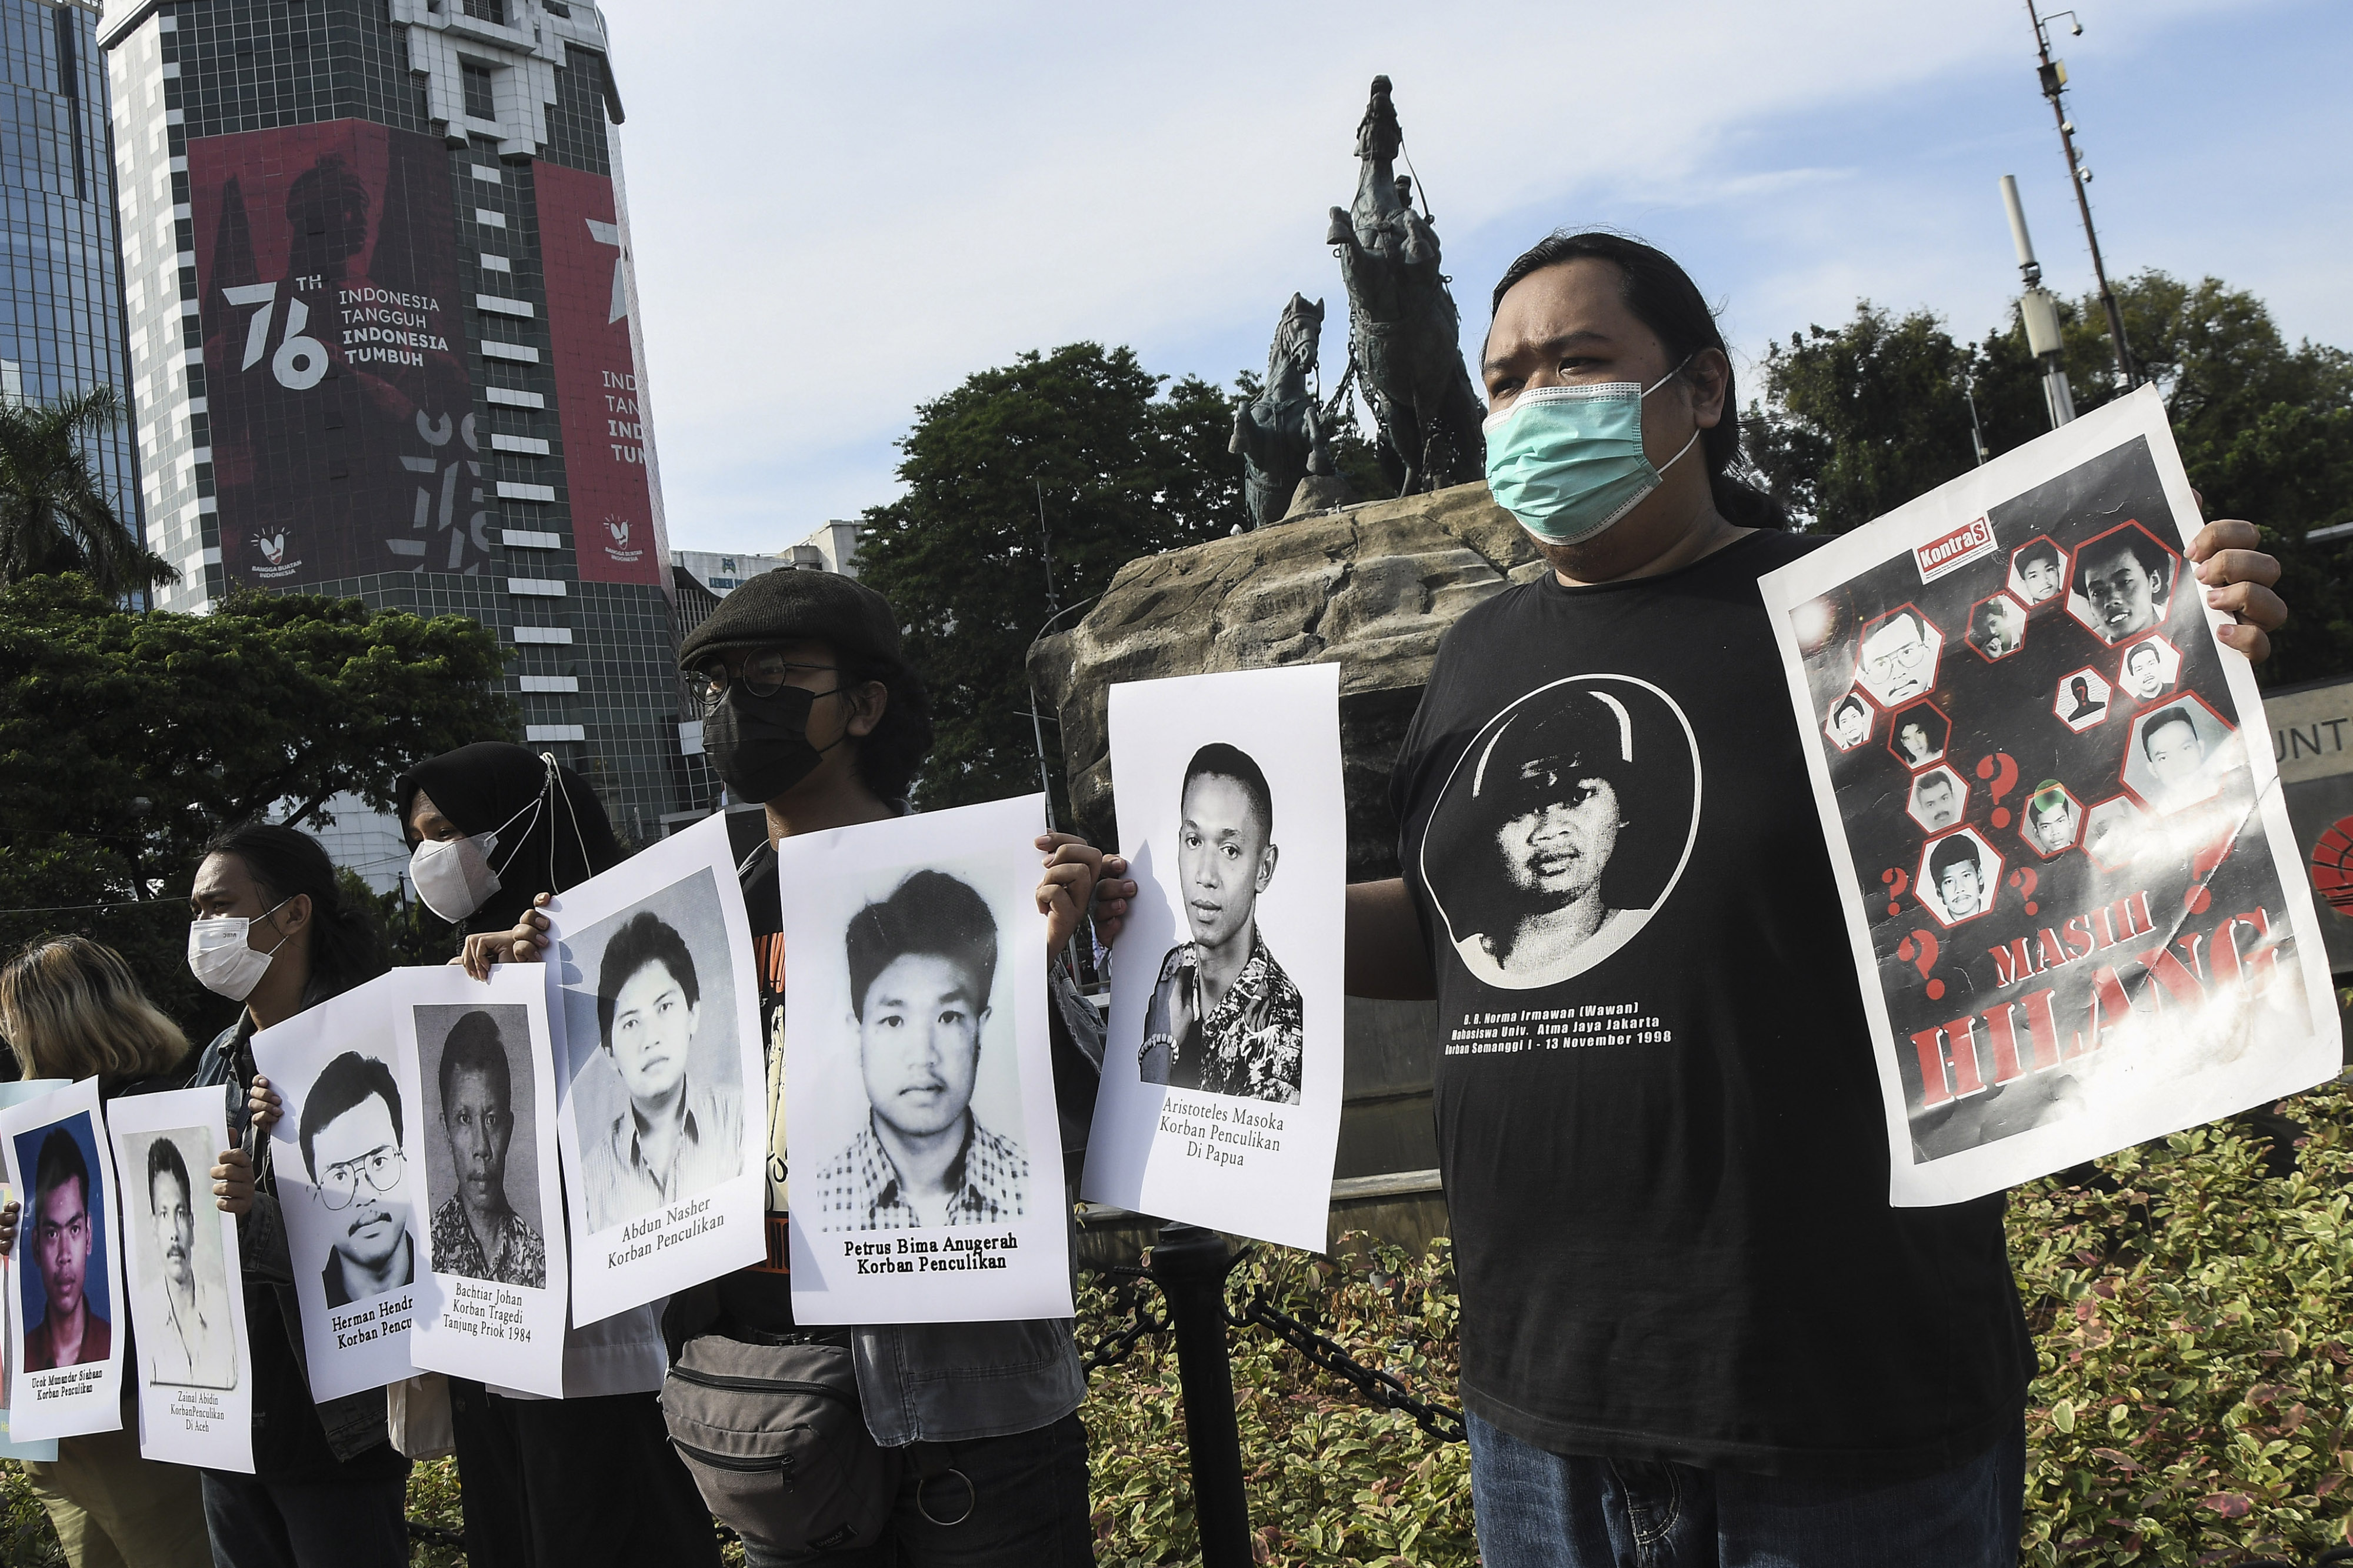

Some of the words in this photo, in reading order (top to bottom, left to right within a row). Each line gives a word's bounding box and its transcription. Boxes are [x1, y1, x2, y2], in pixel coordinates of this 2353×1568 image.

[339, 288, 440, 312] INDONESIA
[341, 308, 426, 329] TANGGUH
[222, 282, 328, 390] 76
[296, 274, 322, 291] TH
[343, 326, 449, 351] INDONESIA
[345, 346, 424, 366] TUMBUH
[602, 370, 636, 391] IND
[259, 569, 296, 578] INDONESIA
[278, 560, 302, 572] BUATAN
[1988, 890, 2157, 989] MASIH
[1464, 1014, 1471, 1025] B.
[1484, 1012, 1517, 1025] Norma
[1521, 1008, 1575, 1022] Irmawan
[1579, 1002, 1639, 1017] (Wawan)
[1910, 906, 2280, 1110] HILANG
[1451, 1028, 1498, 1041] Mahasiswa
[1501, 1025, 1529, 1037] Univ.
[1537, 1024, 1568, 1035] Atma
[1572, 1021, 1601, 1033] Jaya
[1606, 1017, 1659, 1030] Jakarta
[1445, 1043, 1469, 1056] Korban
[1472, 1042, 1524, 1054] Semanggi
[1545, 1037, 1559, 1050] 13
[1562, 1035, 1632, 1049] November
[1637, 1030, 1672, 1044] 1998
[1162, 1096, 1228, 1122] Aristoteles
[1232, 1107, 1284, 1130] Masoka
[1159, 1116, 1205, 1138] Korban
[1209, 1125, 1280, 1151] Penculikan
[1187, 1141, 1202, 1158] Di
[1205, 1144, 1244, 1167] Papua
[622, 1219, 661, 1243] Abdun
[666, 1199, 710, 1225] Nasher
[608, 1243, 651, 1269] Korban
[656, 1215, 724, 1250] Penculikan
[844, 1241, 891, 1256] Petrus
[896, 1237, 938, 1254] Bima
[943, 1232, 1018, 1257] Anugerah
[857, 1257, 914, 1274] Korban
[918, 1253, 1006, 1272] Penculikan
[455, 1283, 492, 1301] Bachtiar
[496, 1289, 522, 1306] Johan
[332, 1309, 376, 1332] Herman
[452, 1299, 485, 1317] Korban
[489, 1305, 522, 1325] Tragedi
[337, 1327, 378, 1349] Korban
[444, 1314, 478, 1336] Tanjung
[481, 1322, 504, 1338] Priok
[508, 1326, 531, 1343] 1984
[32, 1376, 46, 1388] Ucok
[48, 1372, 77, 1386] Munandar
[79, 1369, 102, 1381] Siahaan
[37, 1389, 59, 1400] Korban
[61, 1383, 92, 1397] Penculikan
[178, 1391, 197, 1403] Zainal
[199, 1392, 218, 1405] Abidin
[171, 1403, 224, 1420] KorbanPenculikan
[186, 1419, 193, 1430] Di
[195, 1421, 209, 1432] Aceh
